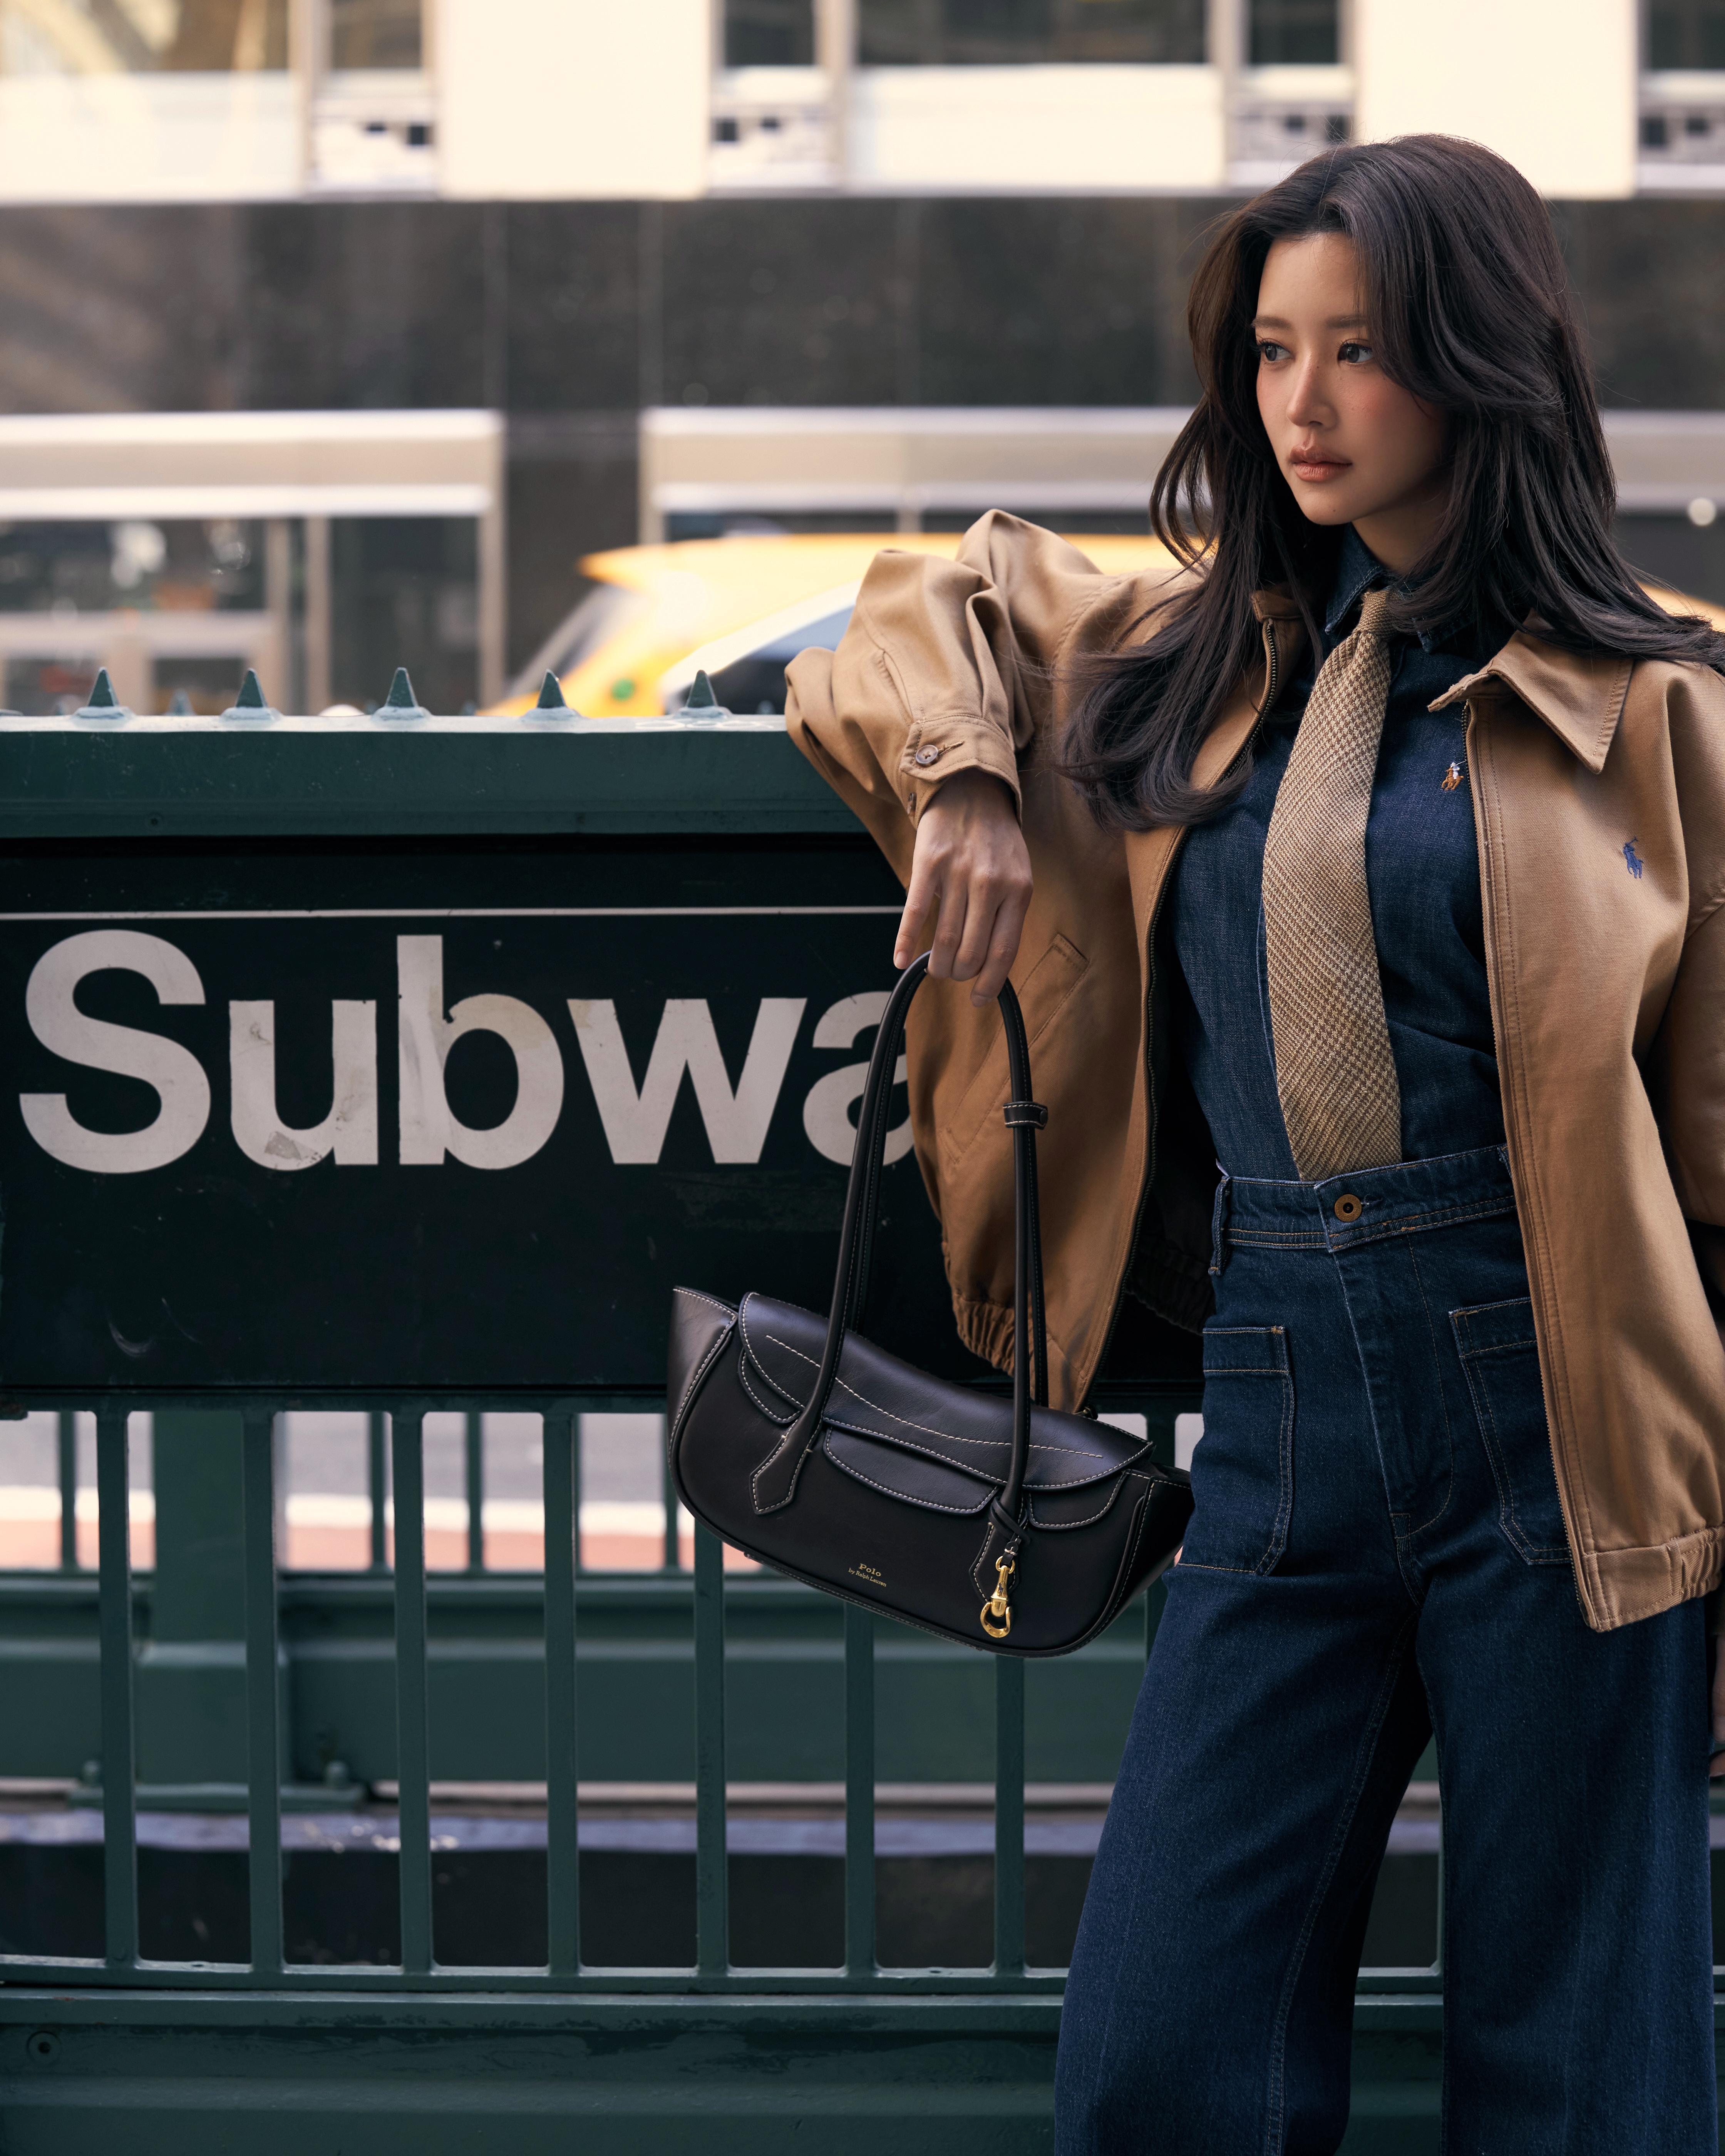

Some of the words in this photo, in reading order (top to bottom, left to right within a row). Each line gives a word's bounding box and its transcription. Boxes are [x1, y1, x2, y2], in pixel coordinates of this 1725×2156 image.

[858, 1563, 881, 1577] Polo
[856, 1570, 869, 1580] Ralph
[869, 1576, 886, 1587] Lauren
